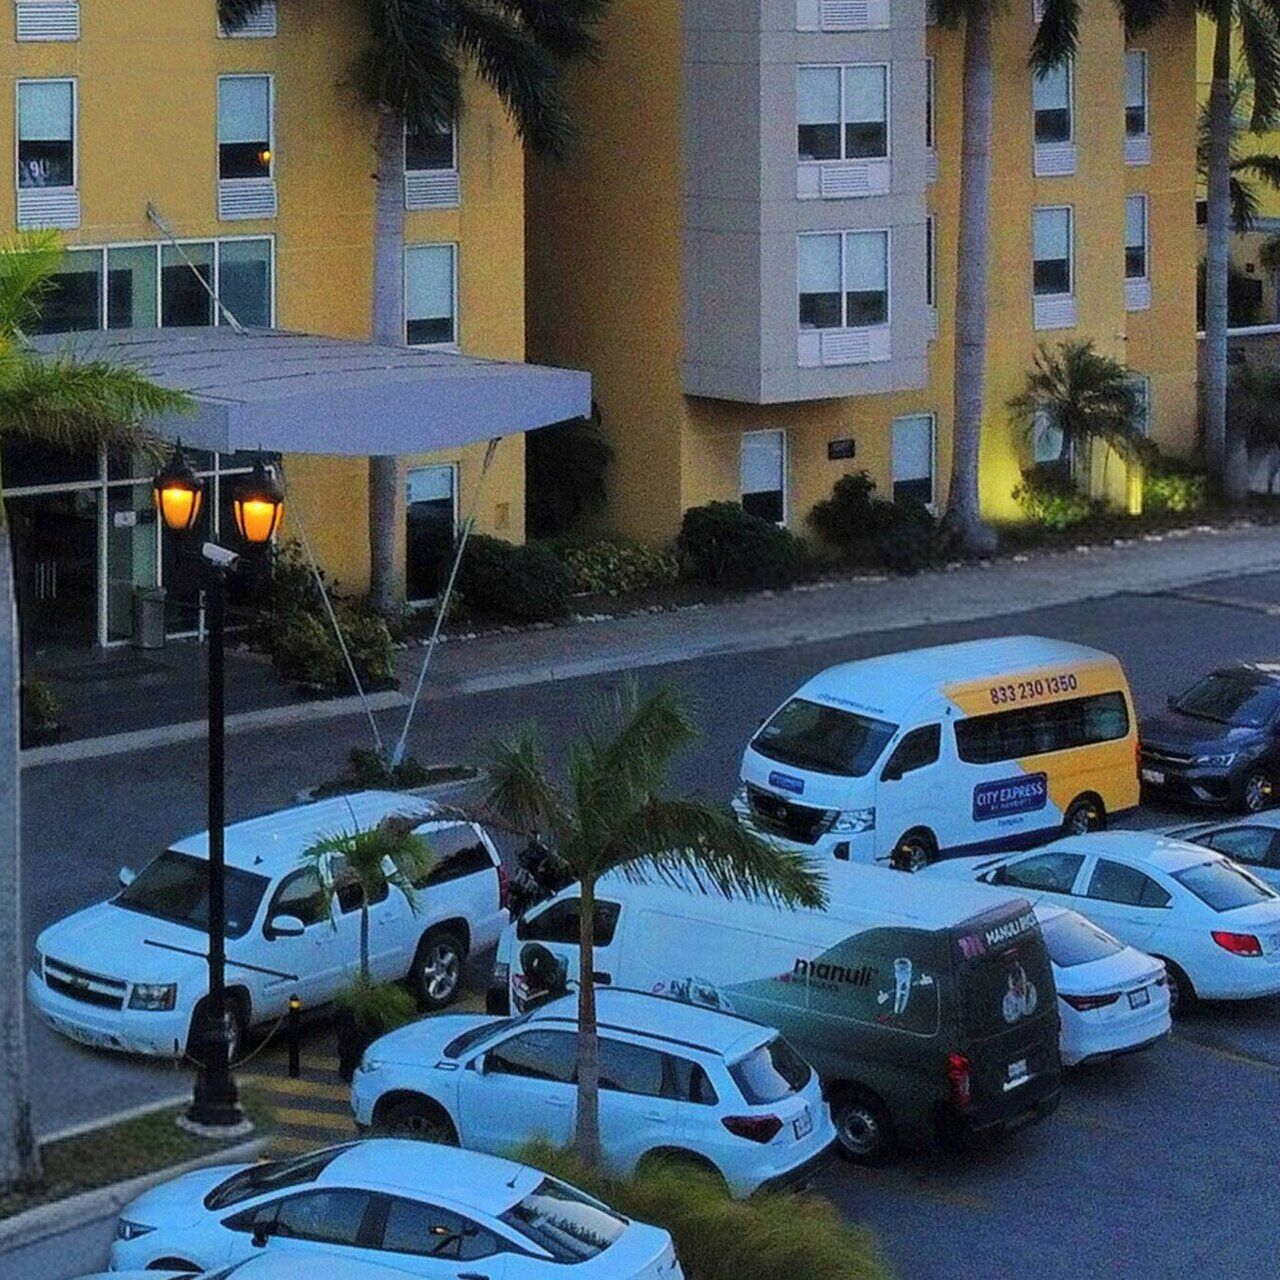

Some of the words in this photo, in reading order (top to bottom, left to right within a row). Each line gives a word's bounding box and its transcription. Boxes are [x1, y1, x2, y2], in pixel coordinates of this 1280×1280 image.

[990, 685, 1016, 705] 833
[1018, 679, 1044, 699] 230
[1045, 673, 1078, 695] 1350
[977, 790, 999, 806] CITY
[1000, 781, 1044, 802] EXPRESS
[793, 957, 873, 987] manuli
